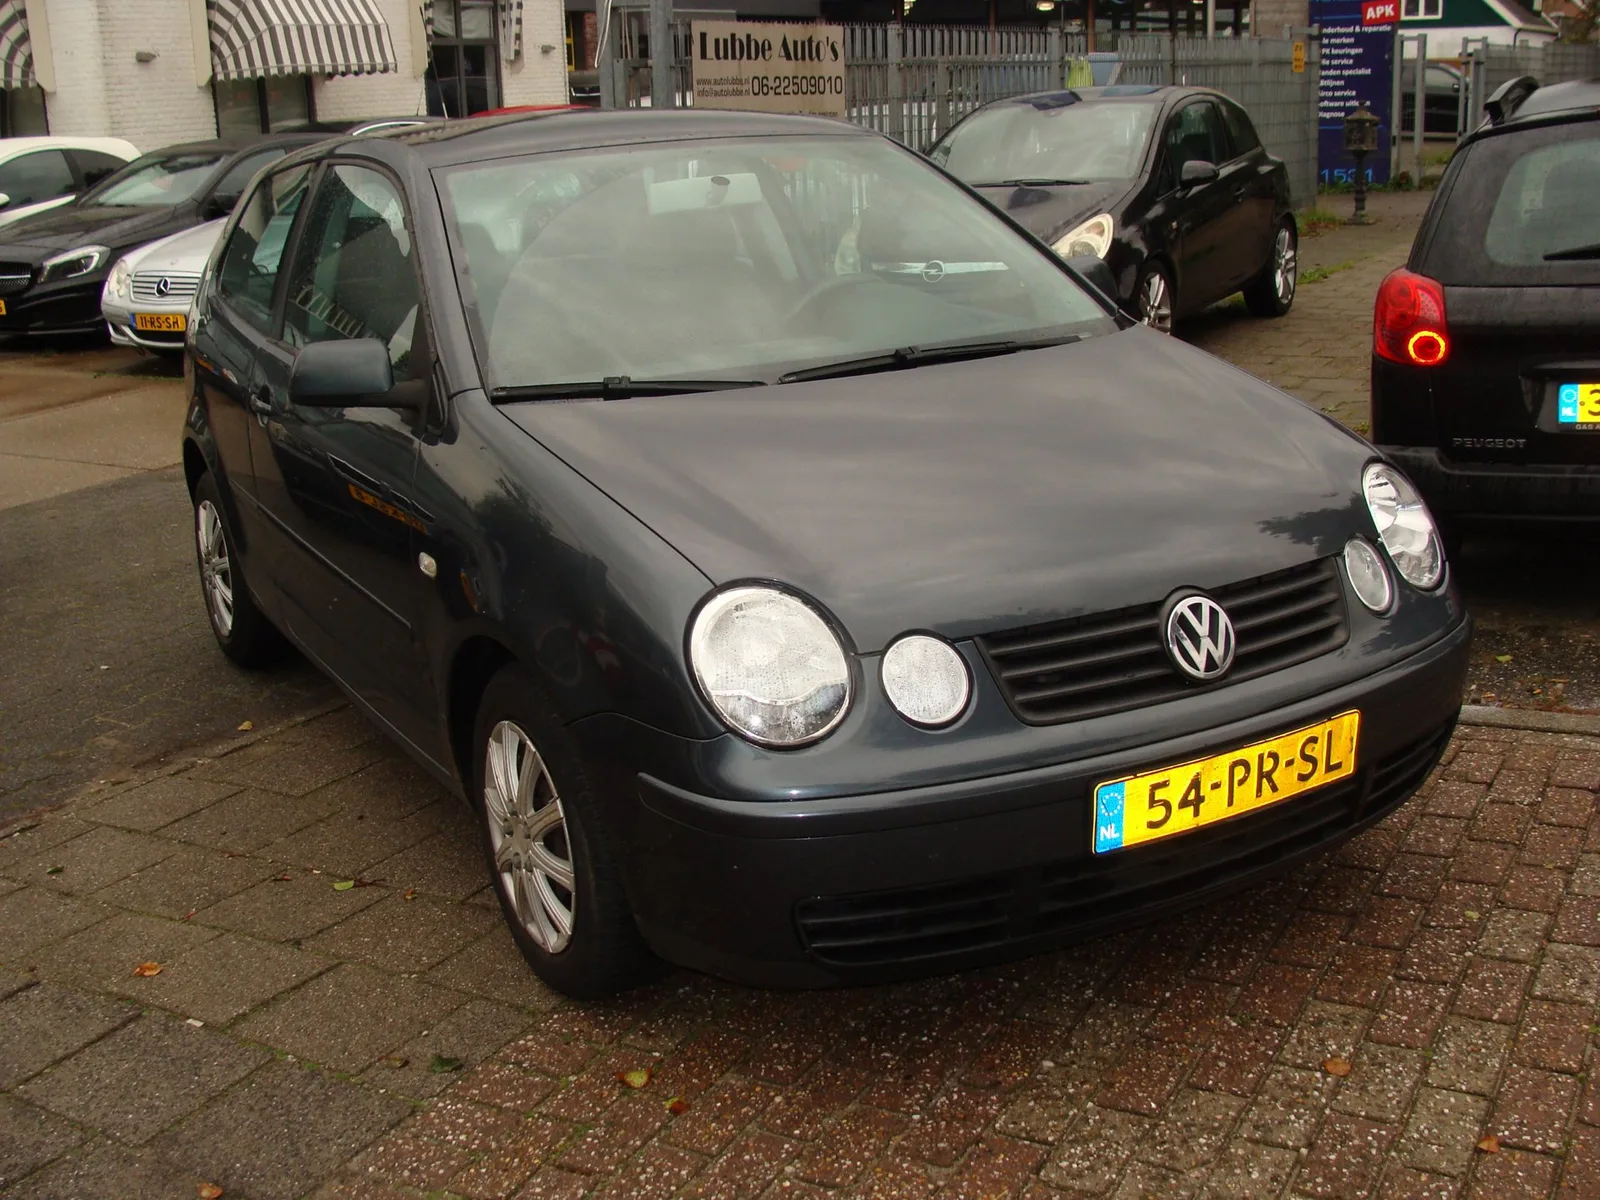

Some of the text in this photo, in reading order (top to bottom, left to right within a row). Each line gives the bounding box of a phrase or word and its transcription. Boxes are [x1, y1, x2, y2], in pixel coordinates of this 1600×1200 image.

[1365, 4, 1395, 20] APK
[1322, 25, 1355, 34] nderhoud
[1361, 24, 1392, 34] reparatie
[1330, 36, 1355, 44] merken
[700, 32, 839, 62] Lubbe Auto's
[1331, 47, 1363, 56] keuringen
[1331, 58, 1353, 66] service
[1342, 68, 1371, 77] specialist
[696, 76, 751, 86] www.autolubbe.nl
[751, 75, 843, 96] 06-22509010
[1334, 89, 1356, 97] service
[139, 315, 180, 329] 11-RS-SH
[1561, 406, 1577, 417] NL
[1452, 437, 1527, 449] PEUGEOT
[1146, 729, 1344, 829] 54-PR-SL
[1100, 823, 1120, 842] NL
